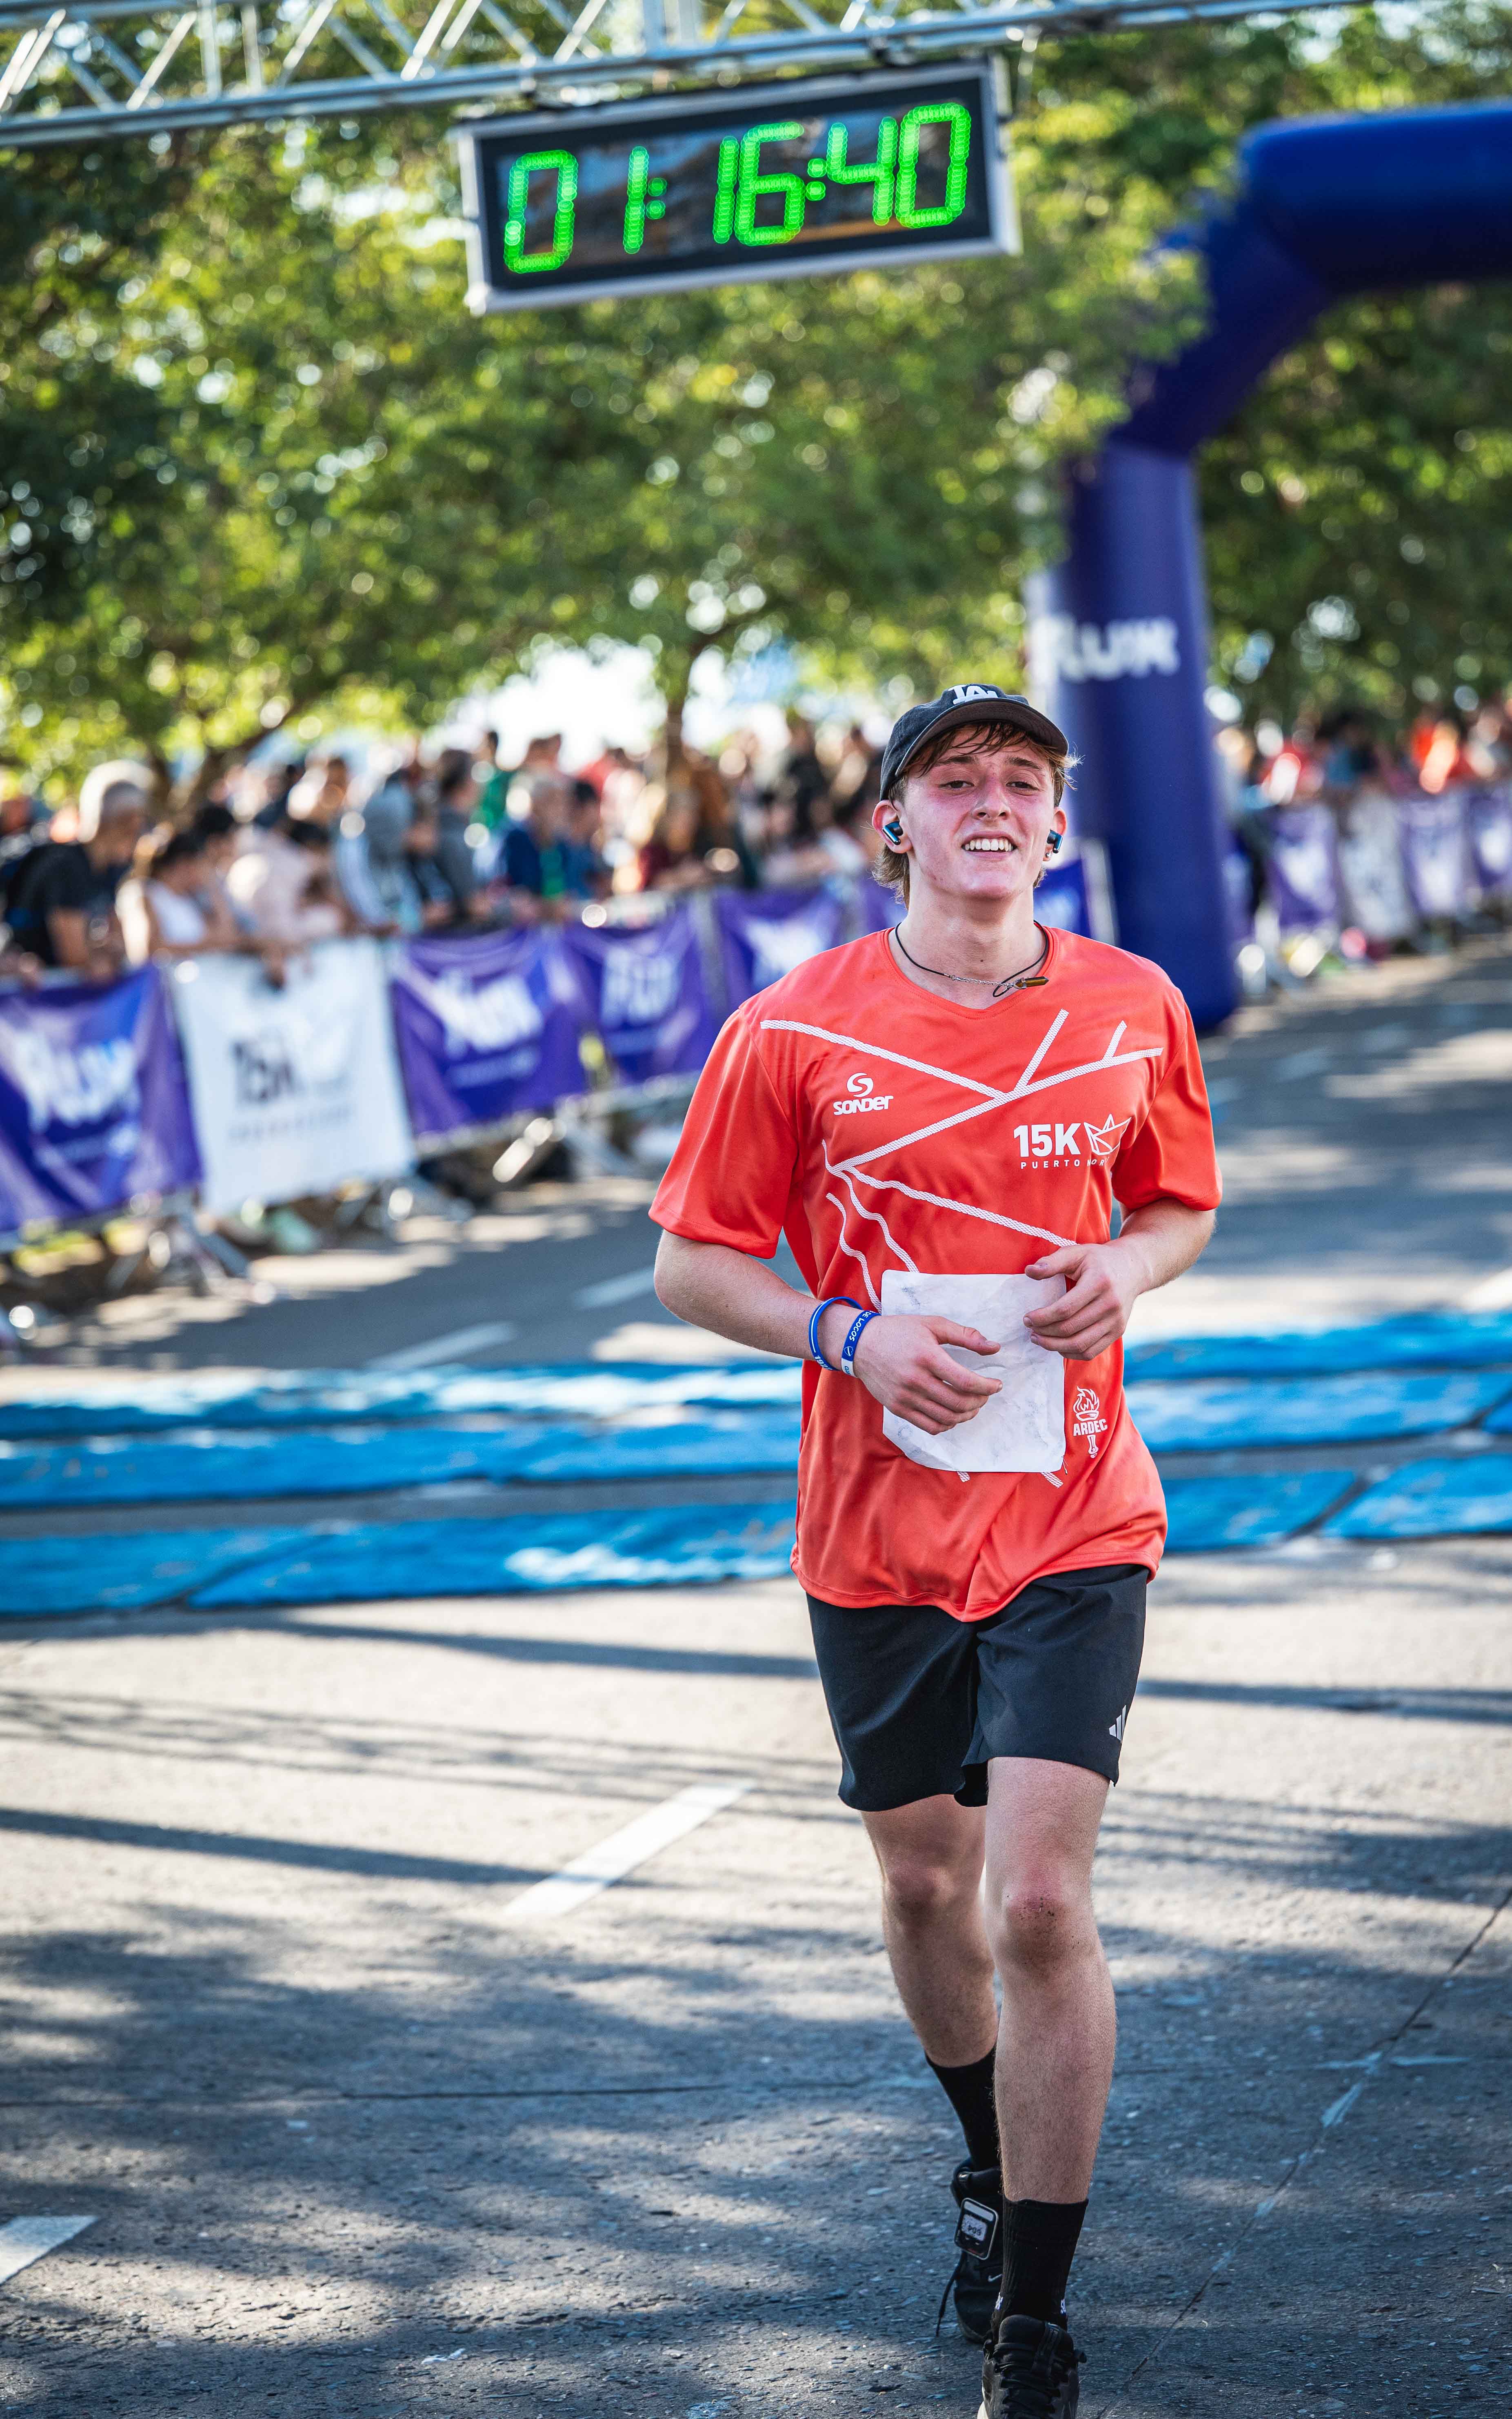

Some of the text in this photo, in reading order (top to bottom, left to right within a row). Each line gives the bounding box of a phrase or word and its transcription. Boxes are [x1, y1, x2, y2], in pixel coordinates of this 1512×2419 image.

[1013, 1123, 1081, 1157] 15K
[1021, 1159, 1080, 1169] PUERTO
[849, 1317, 865, 1342] LOCOS
[1073, 1418, 1108, 1436] ARDEC
